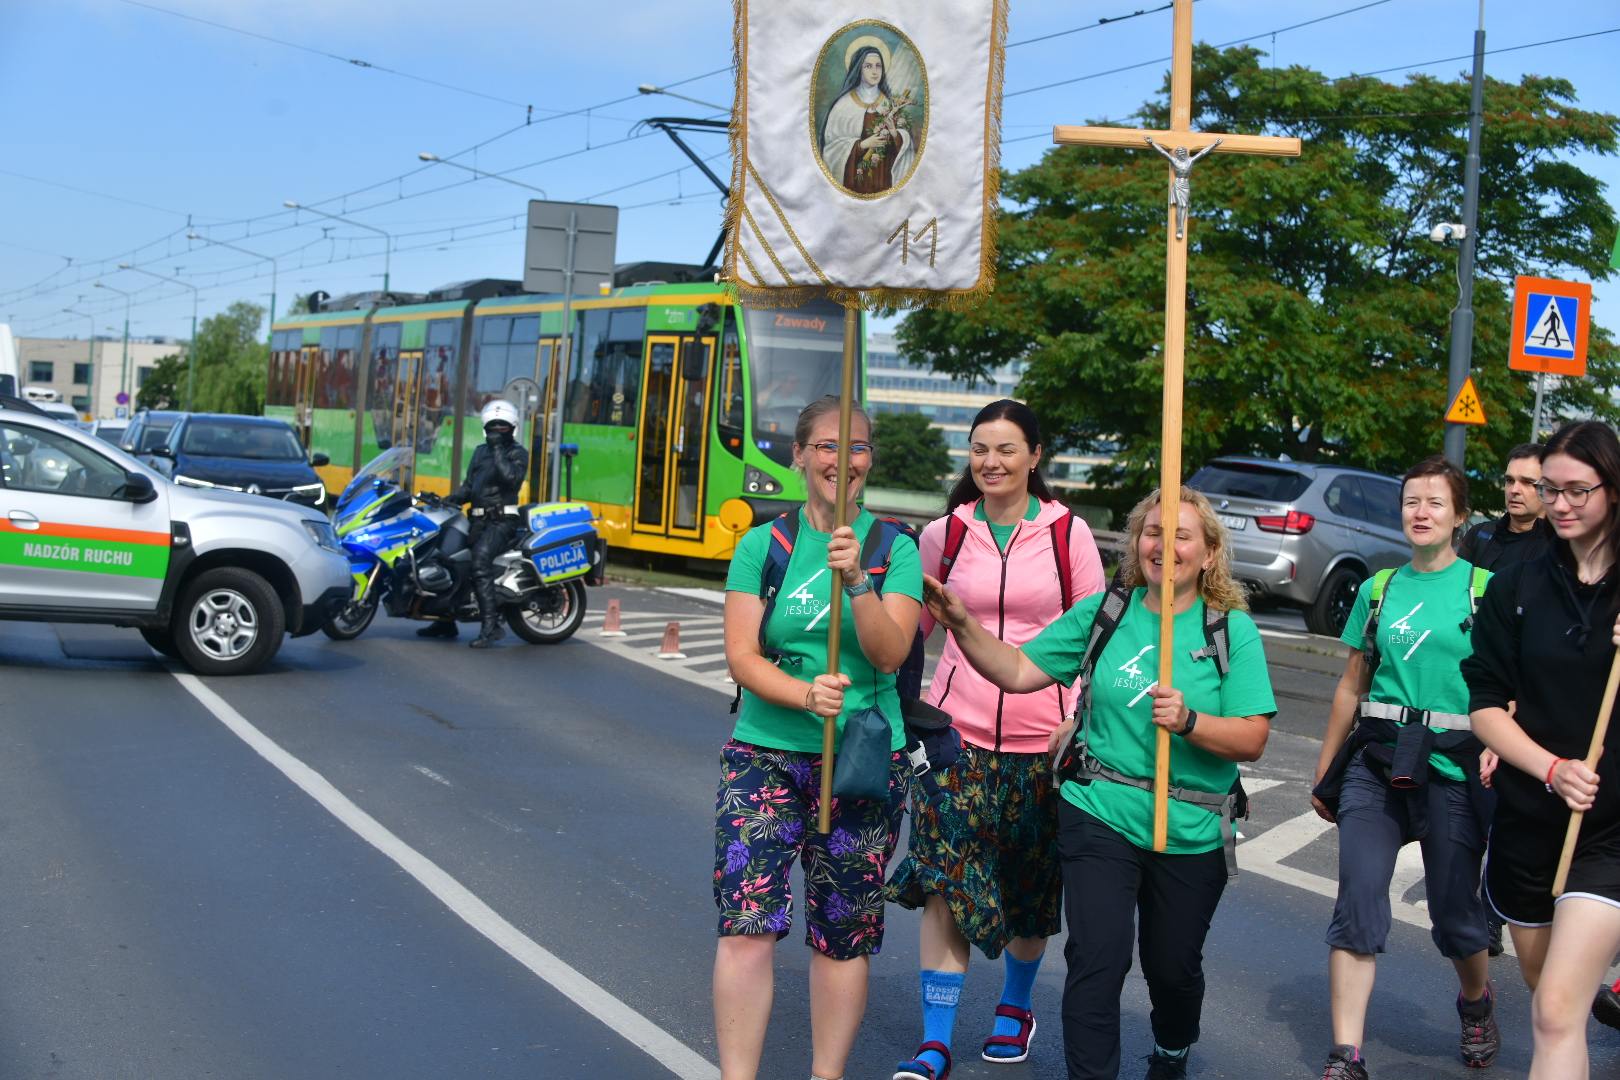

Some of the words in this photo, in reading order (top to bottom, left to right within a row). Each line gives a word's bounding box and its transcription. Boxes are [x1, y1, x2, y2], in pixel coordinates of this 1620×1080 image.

[887, 217, 938, 268] 11
[775, 314, 827, 333] Zawady
[23, 543, 80, 561] NADZÓR
[84, 548, 133, 566] RUCHU
[539, 548, 585, 571] POLICJA
[783, 606, 820, 618] JESUS
[1388, 634, 1415, 645] JESUS
[1112, 677, 1144, 691] JESUS
[1135, 675, 1153, 684] YOU
[926, 992, 960, 1003] GAMES
